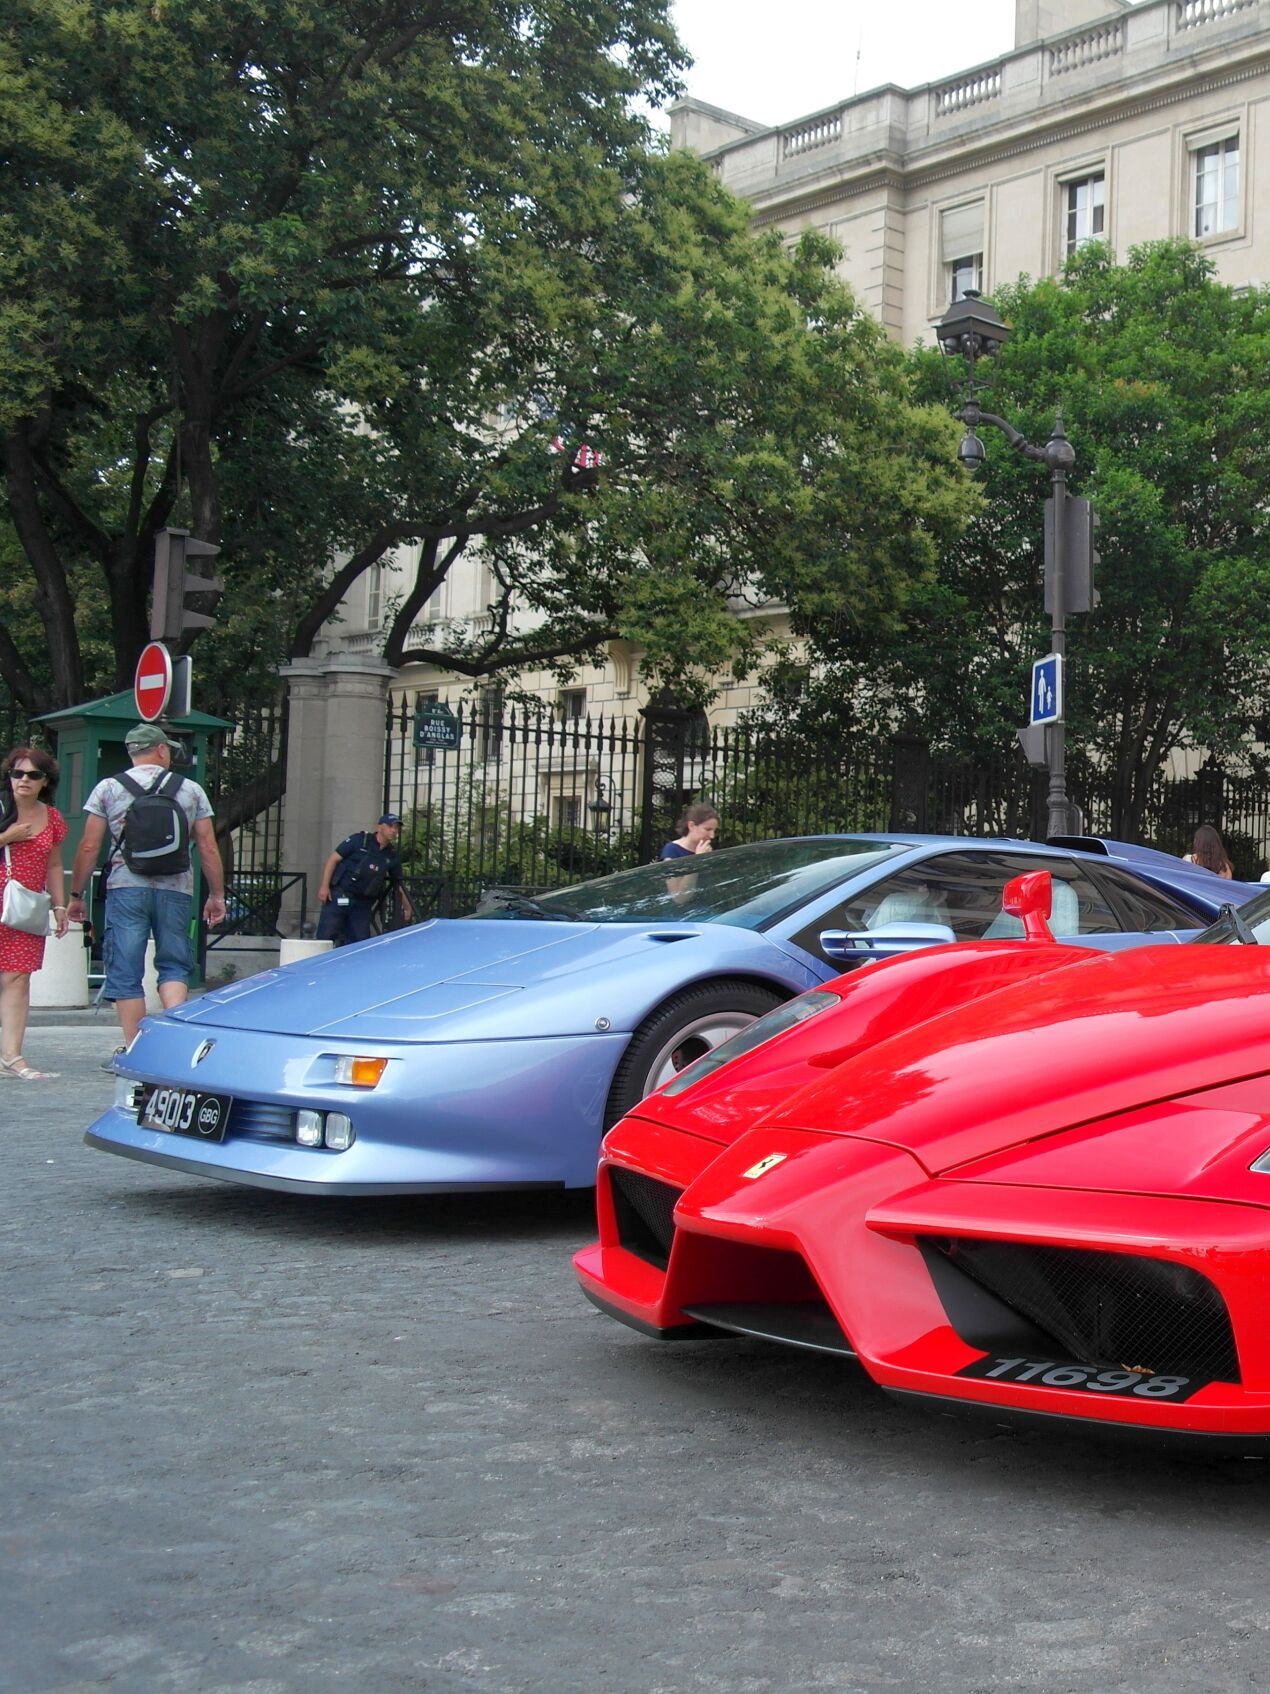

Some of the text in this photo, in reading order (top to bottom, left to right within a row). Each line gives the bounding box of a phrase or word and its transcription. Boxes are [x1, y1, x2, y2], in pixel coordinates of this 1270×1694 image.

[420, 731, 454, 740] D'ANGLAS
[145, 1089, 218, 1128] 49013 GBG
[984, 1358, 1190, 1397] 11698
